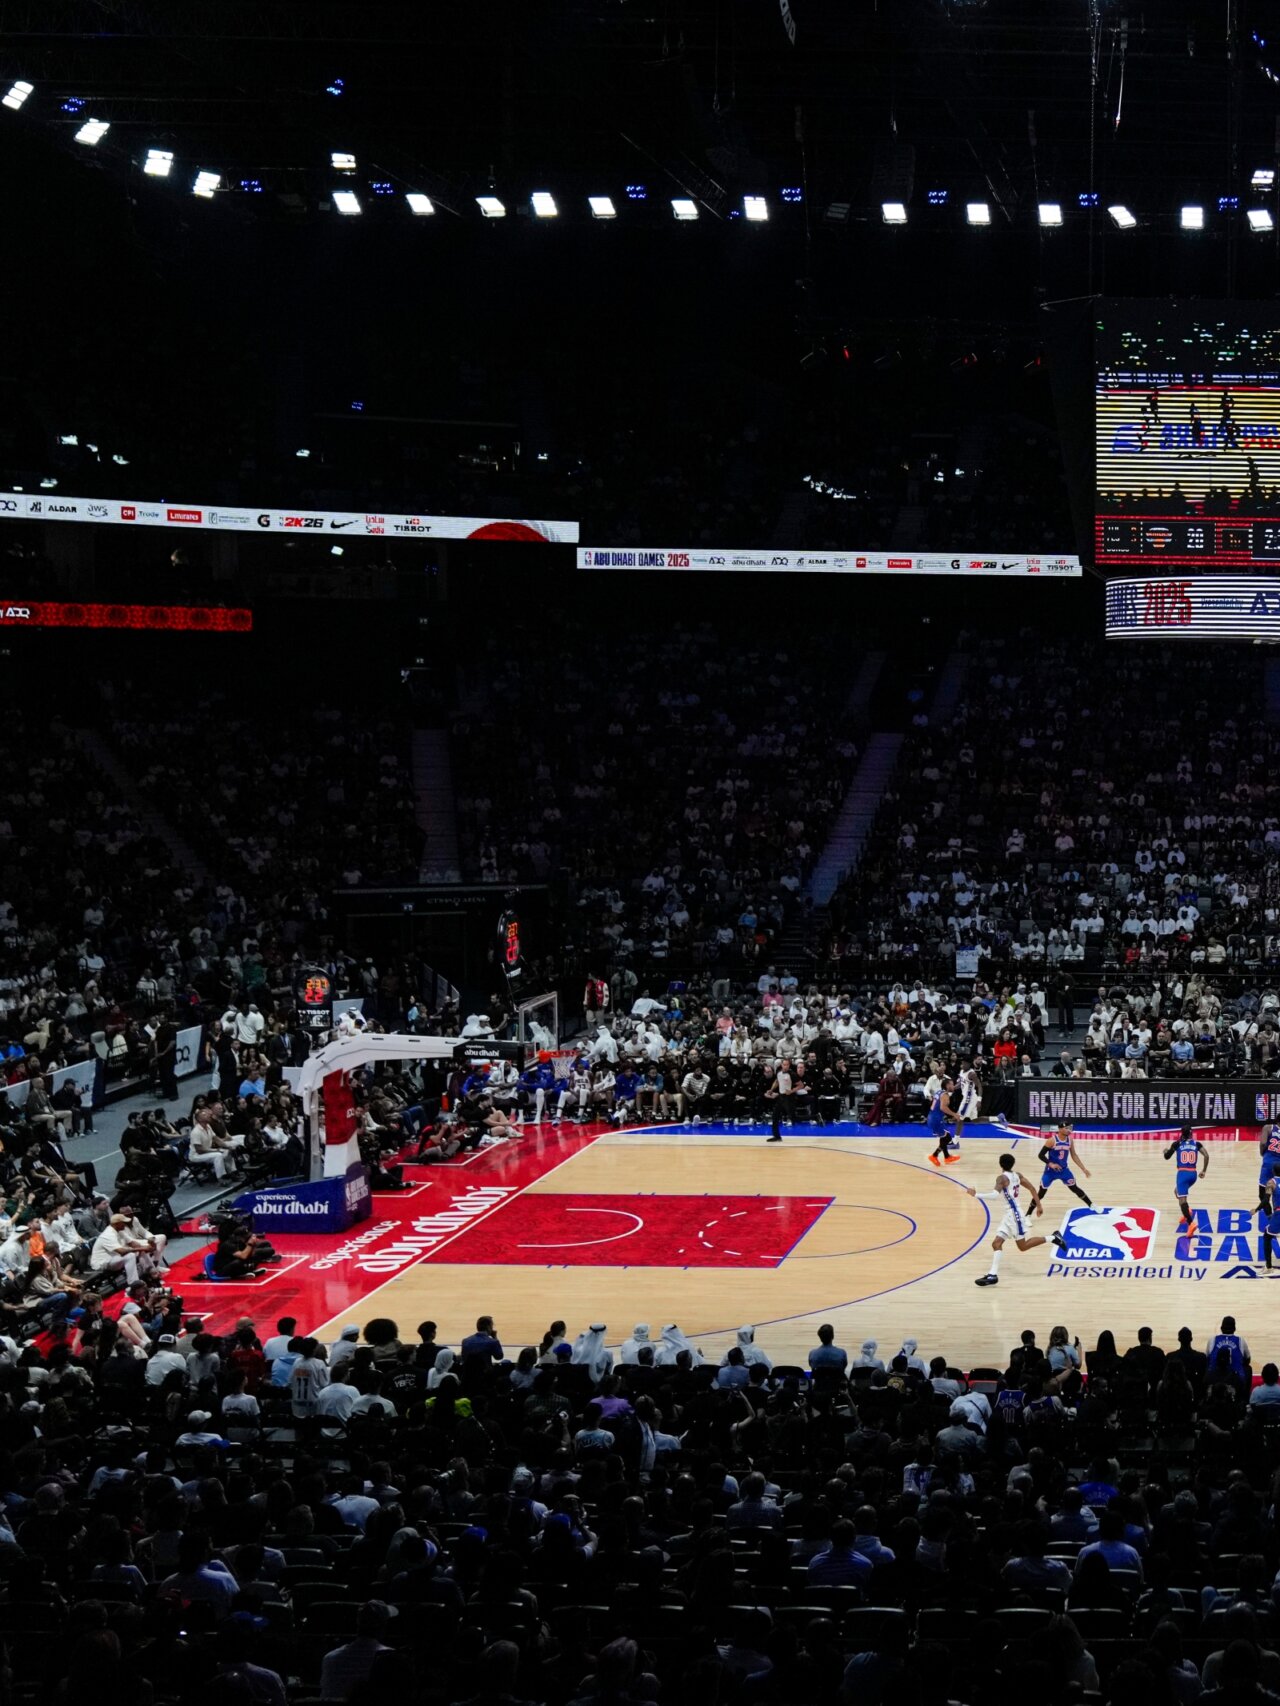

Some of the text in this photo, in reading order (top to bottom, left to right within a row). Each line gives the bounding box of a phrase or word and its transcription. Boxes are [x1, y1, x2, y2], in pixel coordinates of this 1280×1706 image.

[48, 505, 77, 513] ALDAR
[284, 517, 324, 528] 2K26
[594, 551, 610, 566] ABU
[611, 552, 636, 567] DHABI
[637, 553, 665, 567] GAMES
[667, 553, 690, 567] 2025
[1143, 581, 1192, 627] 2025
[5, 607, 30, 619] ADQ
[1028, 1091, 1236, 1120] REWARDS FOR EVERY FAN
[1180, 1151, 1196, 1164] 00
[253, 1201, 283, 1215] abu
[309, 1219, 401, 1270] experience
[355, 1235, 445, 1273] abu
[1066, 1247, 1112, 1259] NBA
[1047, 1263, 1173, 1279] Presented
[1179, 1264, 1207, 1281] by
